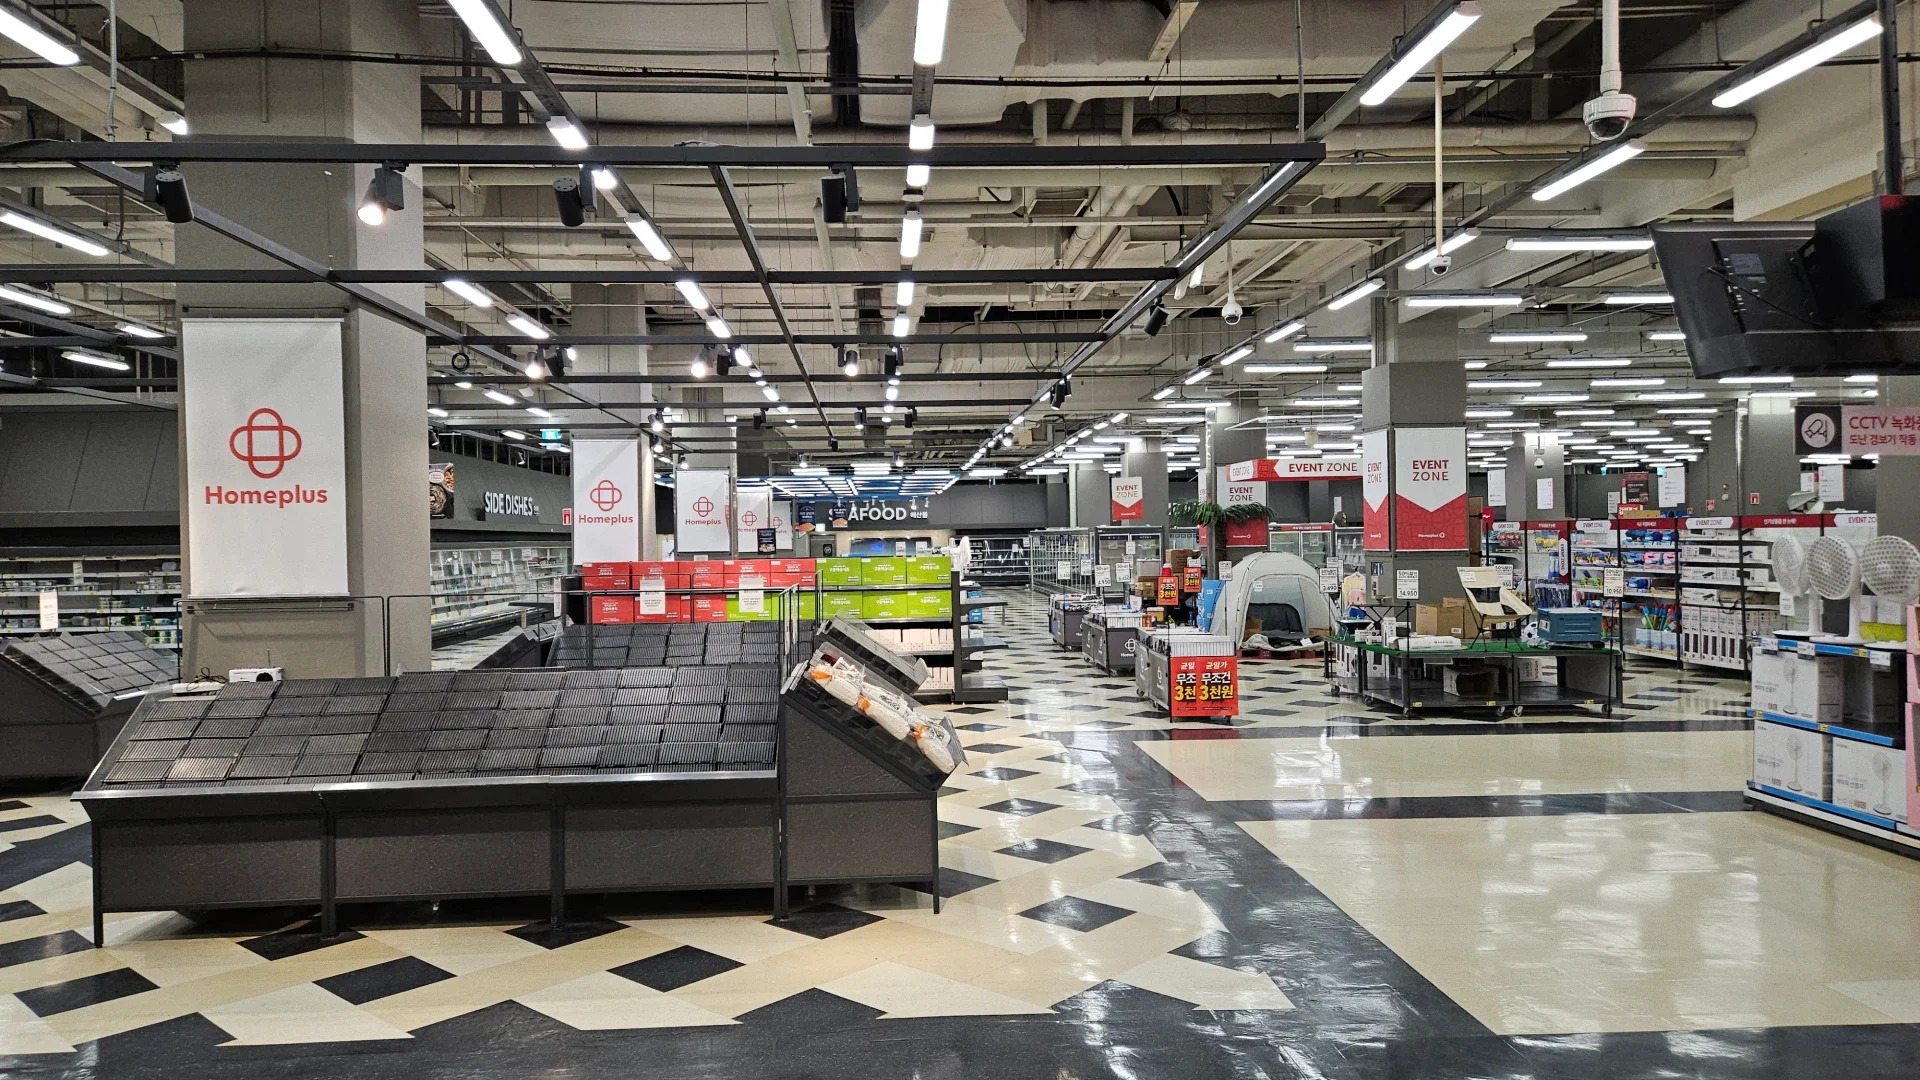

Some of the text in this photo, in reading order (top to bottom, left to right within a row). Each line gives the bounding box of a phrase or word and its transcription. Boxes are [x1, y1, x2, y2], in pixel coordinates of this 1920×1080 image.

[1849, 415, 1920, 431] CCTV 녹화
[1849, 434, 1917, 446] 도난 경보기 작동
[1288, 462, 1358, 473] EVENT ZONE
[1367, 461, 1382, 473] EVENT
[1412, 459, 1449, 470] EVENT
[1367, 473, 1382, 484] ZONE
[1412, 471, 1449, 482] ZONE
[205, 484, 328, 509] Homeplus
[485, 491, 505, 514] SIDE
[505, 493, 533, 516] DISHES
[578, 514, 634, 525] Homeplus
[828, 507, 907, 520] AFOOD
[685, 518, 722, 526] Homeplus
[1159, 590, 1177, 598] 3천원
[1181, 661, 1195, 670] 균일
[1206, 660, 1228, 670] 균일가
[1176, 673, 1196, 685] 무조
[1201, 671, 1231, 685] 무조건
[1174, 685, 1196, 701] 3천
[1199, 684, 1234, 701] 3천원
